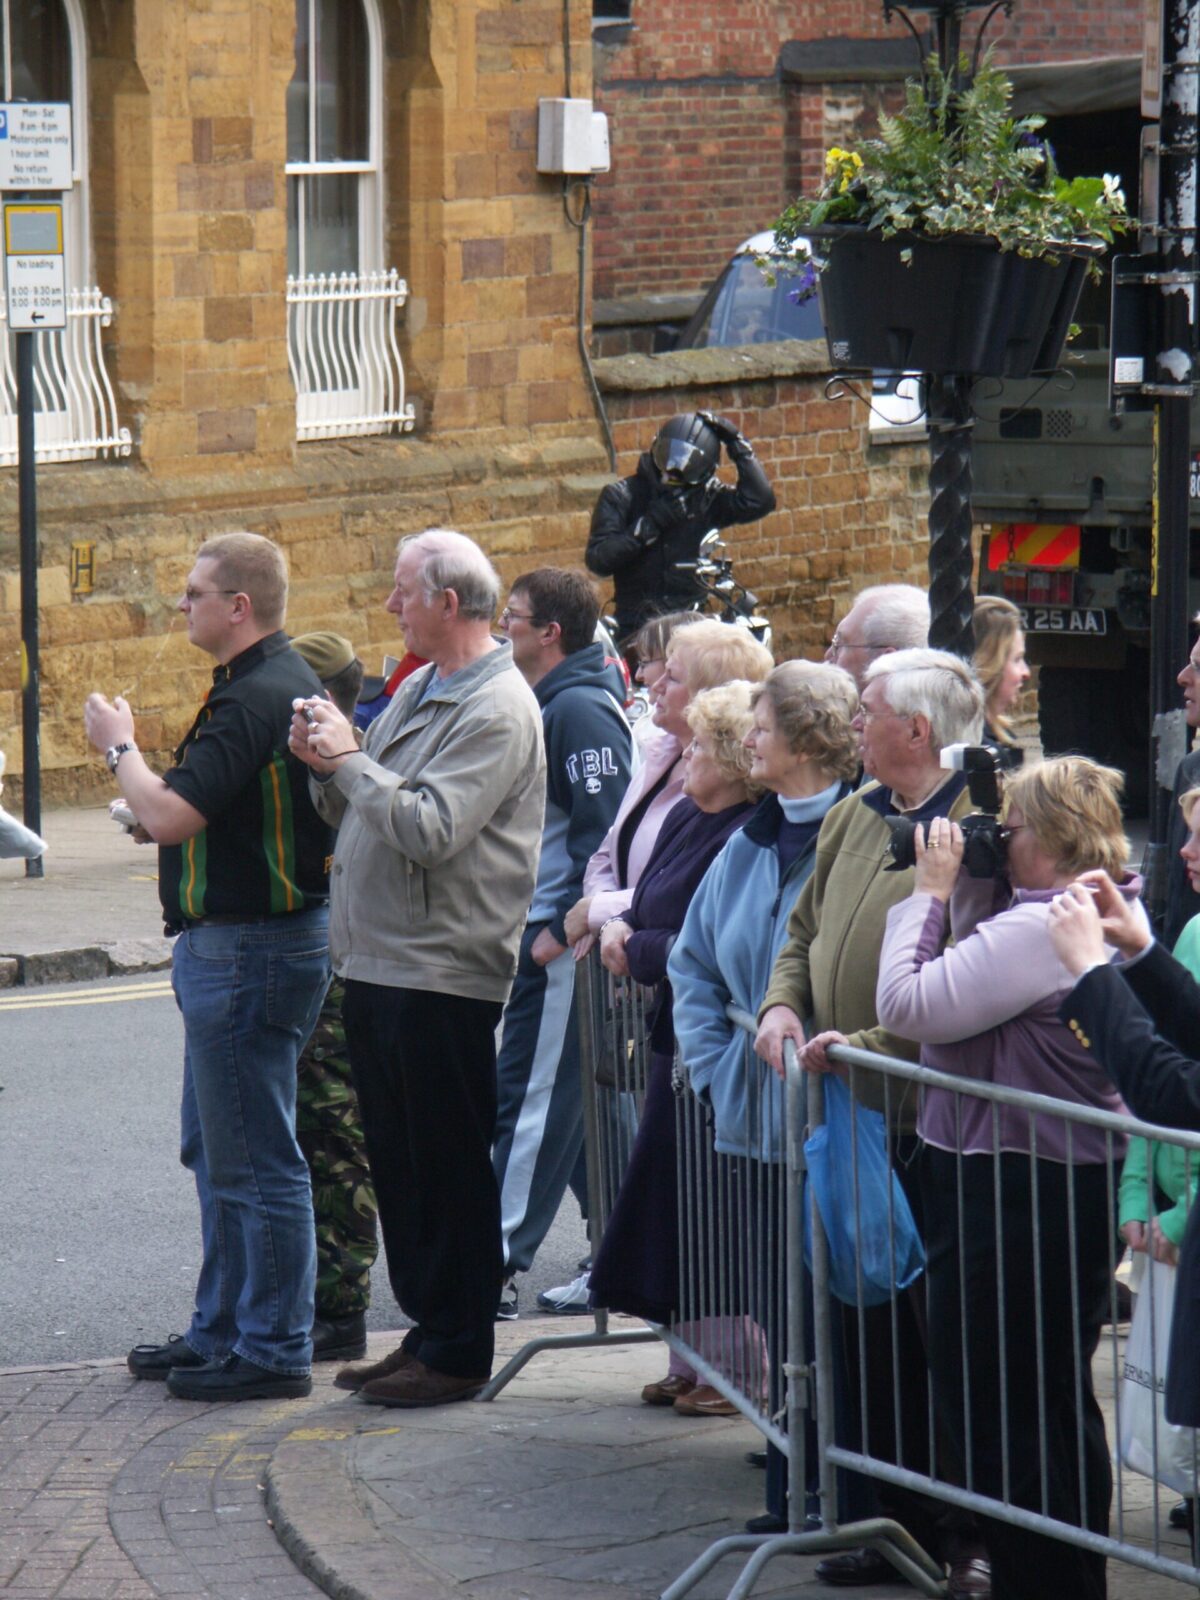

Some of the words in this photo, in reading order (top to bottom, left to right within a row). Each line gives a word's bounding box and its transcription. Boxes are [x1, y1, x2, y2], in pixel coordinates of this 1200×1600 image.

[22, 108, 37, 118] Mon
[42, 108, 55, 118] Sat
[54, 135, 68, 145] only
[15, 149, 31, 158] hour
[33, 148, 49, 158] limit
[13, 164, 24, 173] No
[26, 165, 48, 173] return
[9, 176, 30, 184] within
[37, 176, 53, 184] hour
[16, 260, 27, 269] No
[29, 259, 54, 270] loading
[1034, 609, 1064, 630] 25
[1069, 610, 1098, 632] AA
[565, 746, 618, 784] TBL
